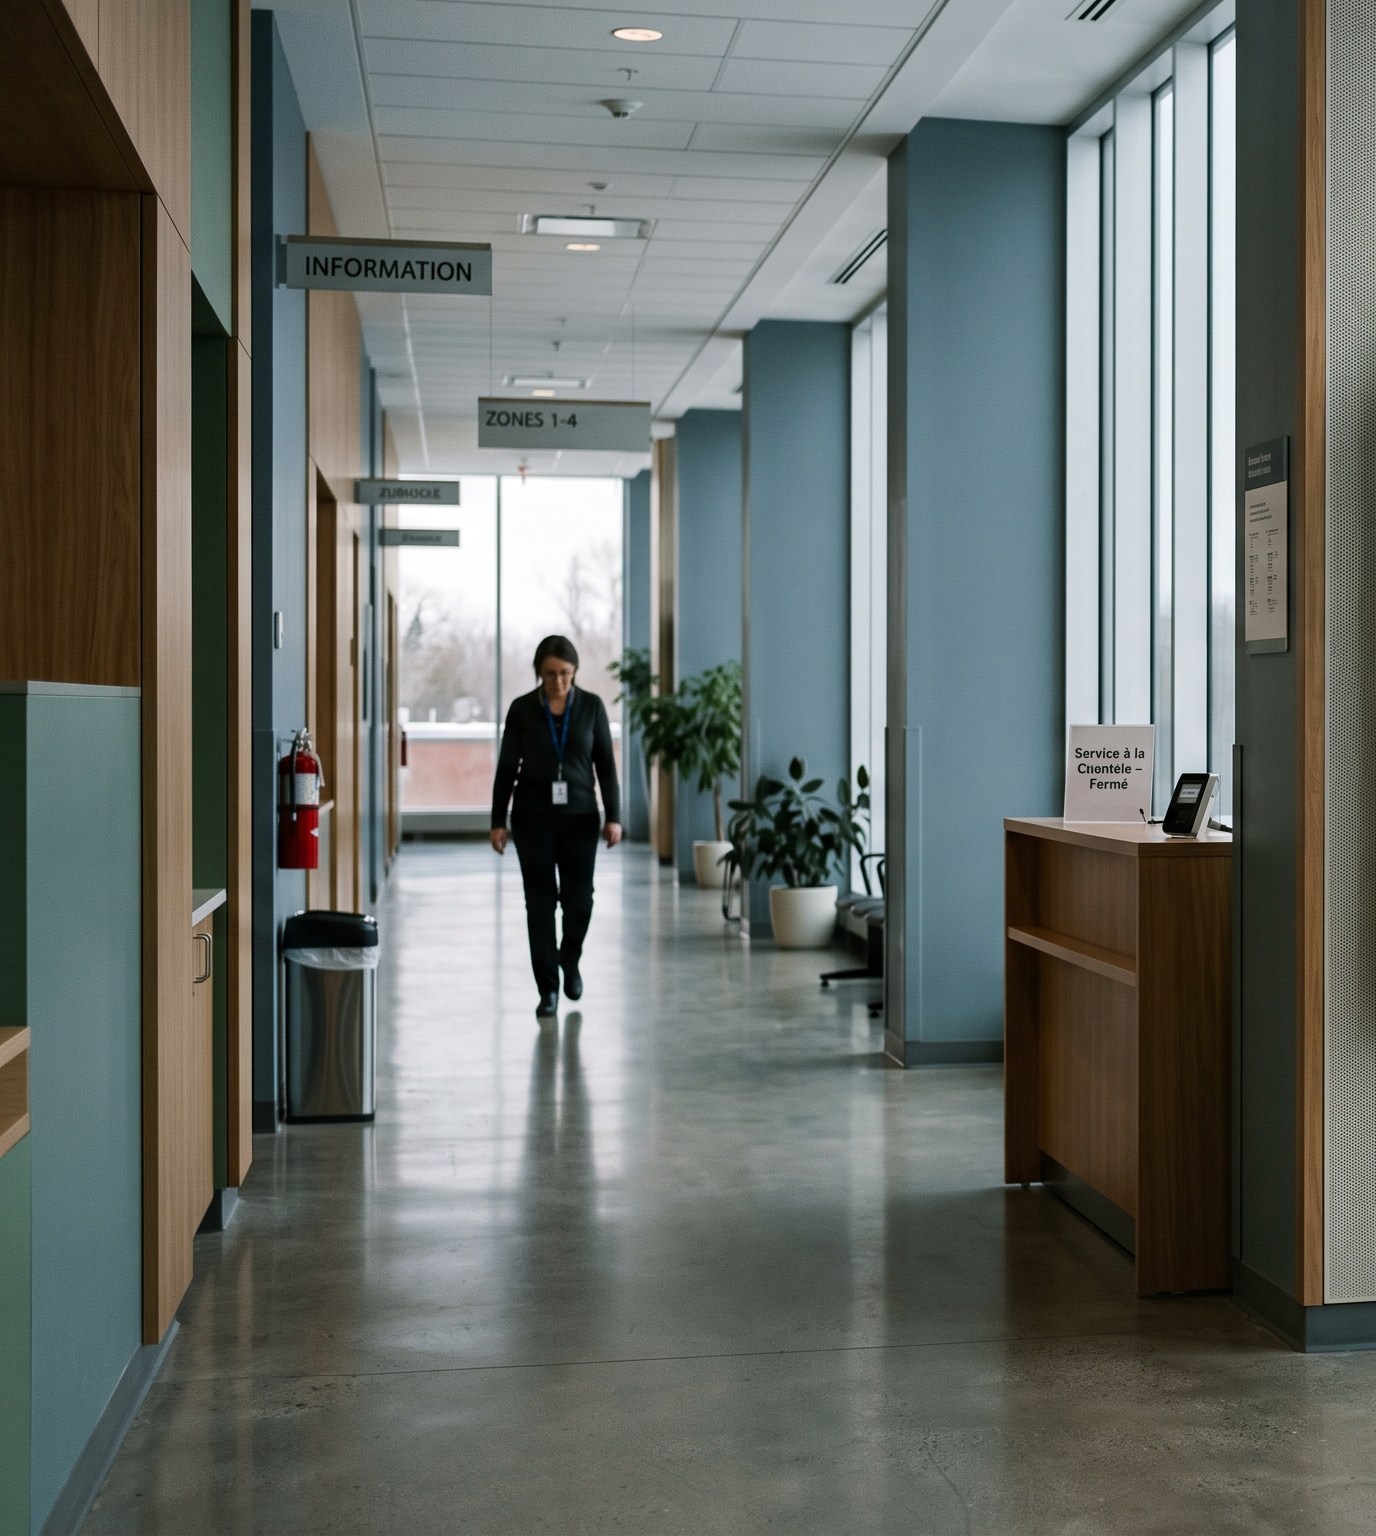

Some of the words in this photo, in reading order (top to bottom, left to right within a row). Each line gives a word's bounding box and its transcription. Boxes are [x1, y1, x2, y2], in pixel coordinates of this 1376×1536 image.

[305, 255, 472, 282] INFORMATION
[485, 410, 544, 428] ZONES
[551, 412, 578, 428] 1-4
[1075, 747, 1120, 759] Service
[1123, 747, 1131, 759] à
[1134, 747, 1145, 759] la
[1089, 778, 1128, 790] Fermé
